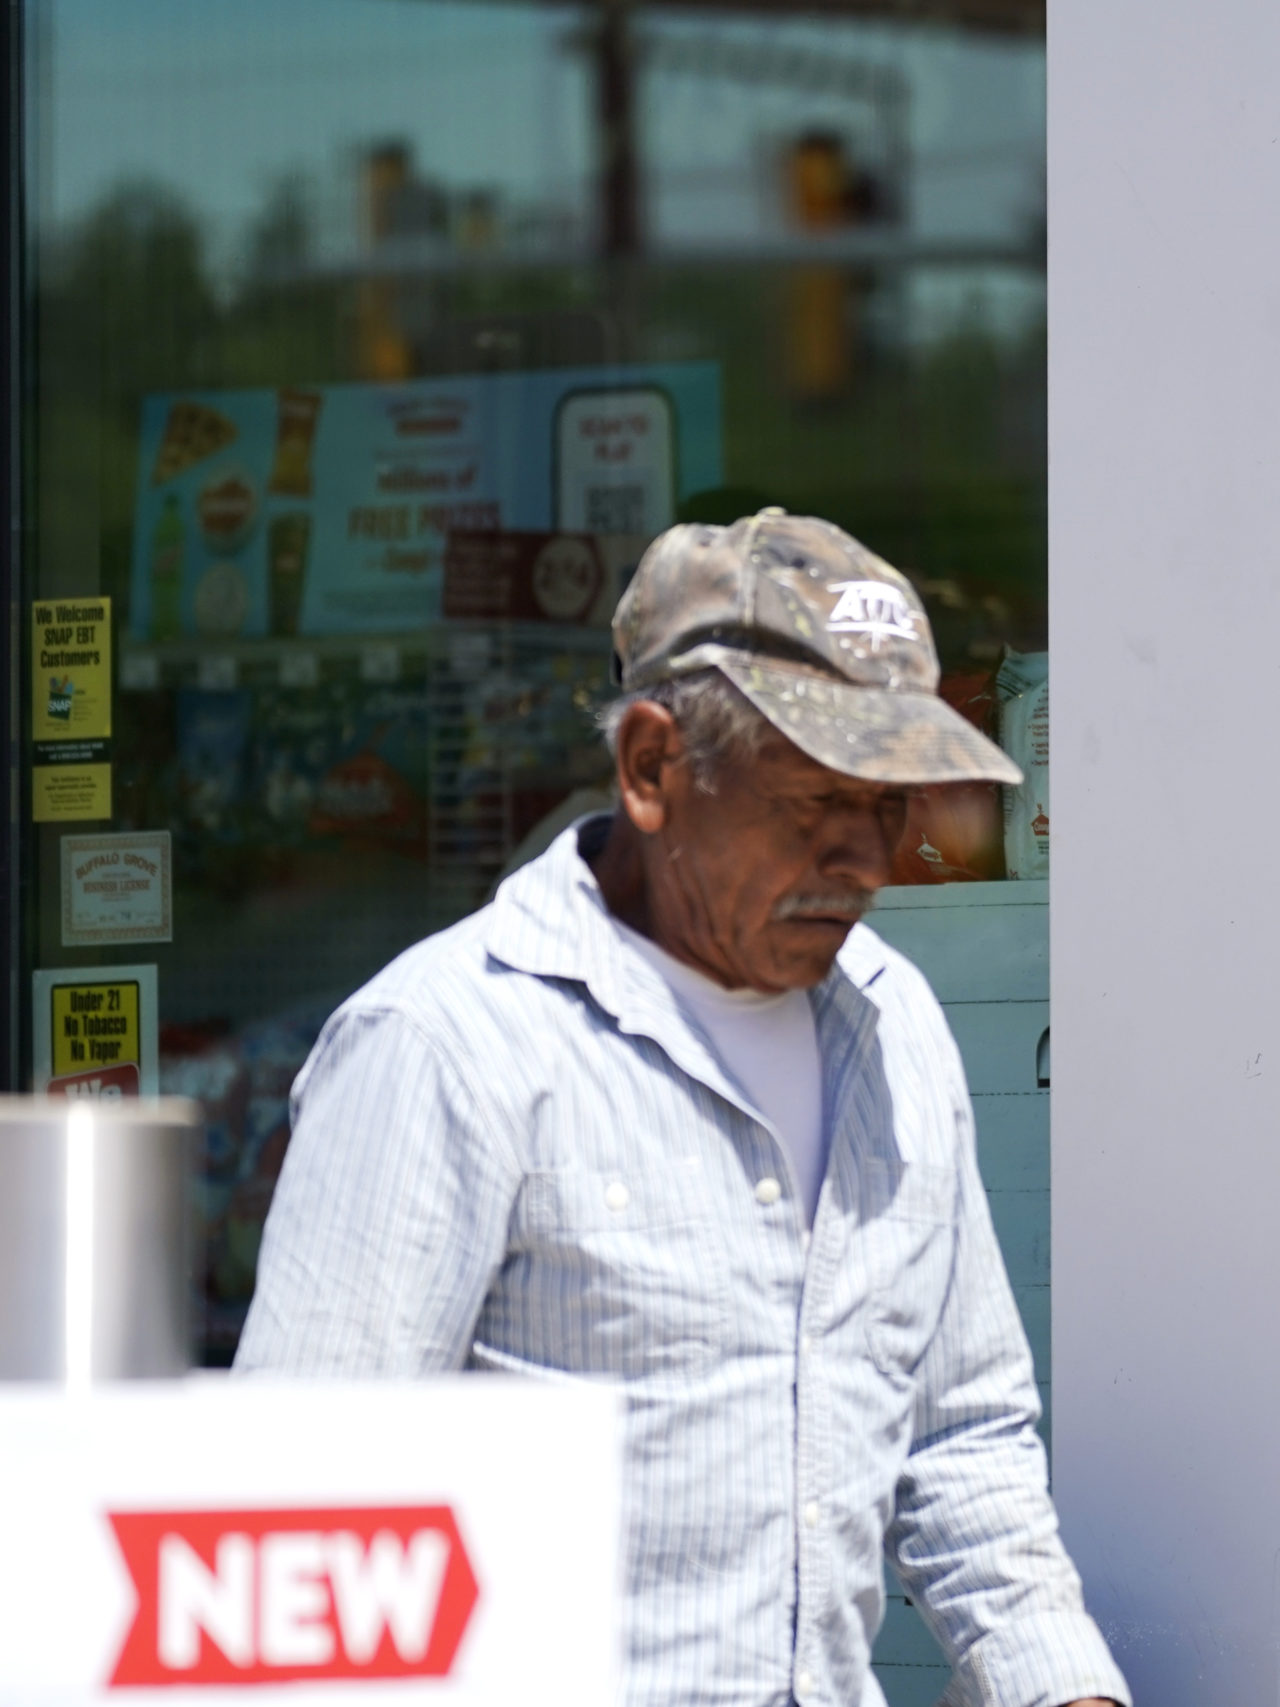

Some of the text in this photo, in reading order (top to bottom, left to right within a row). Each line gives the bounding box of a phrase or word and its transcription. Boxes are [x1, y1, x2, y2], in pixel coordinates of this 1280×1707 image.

[36, 605, 104, 625] We Welcome
[44, 625, 96, 647] SNAP EBT
[40, 649, 100, 669] Customers
[48, 698, 72, 713] SNAP
[75, 852, 158, 880] BUFFALO GROVE
[70, 989, 120, 1013] Under 21
[64, 1014, 127, 1037] No Tobacco
[71, 1039, 122, 1064] No Vapor
[156, 1527, 453, 1670] NEW
